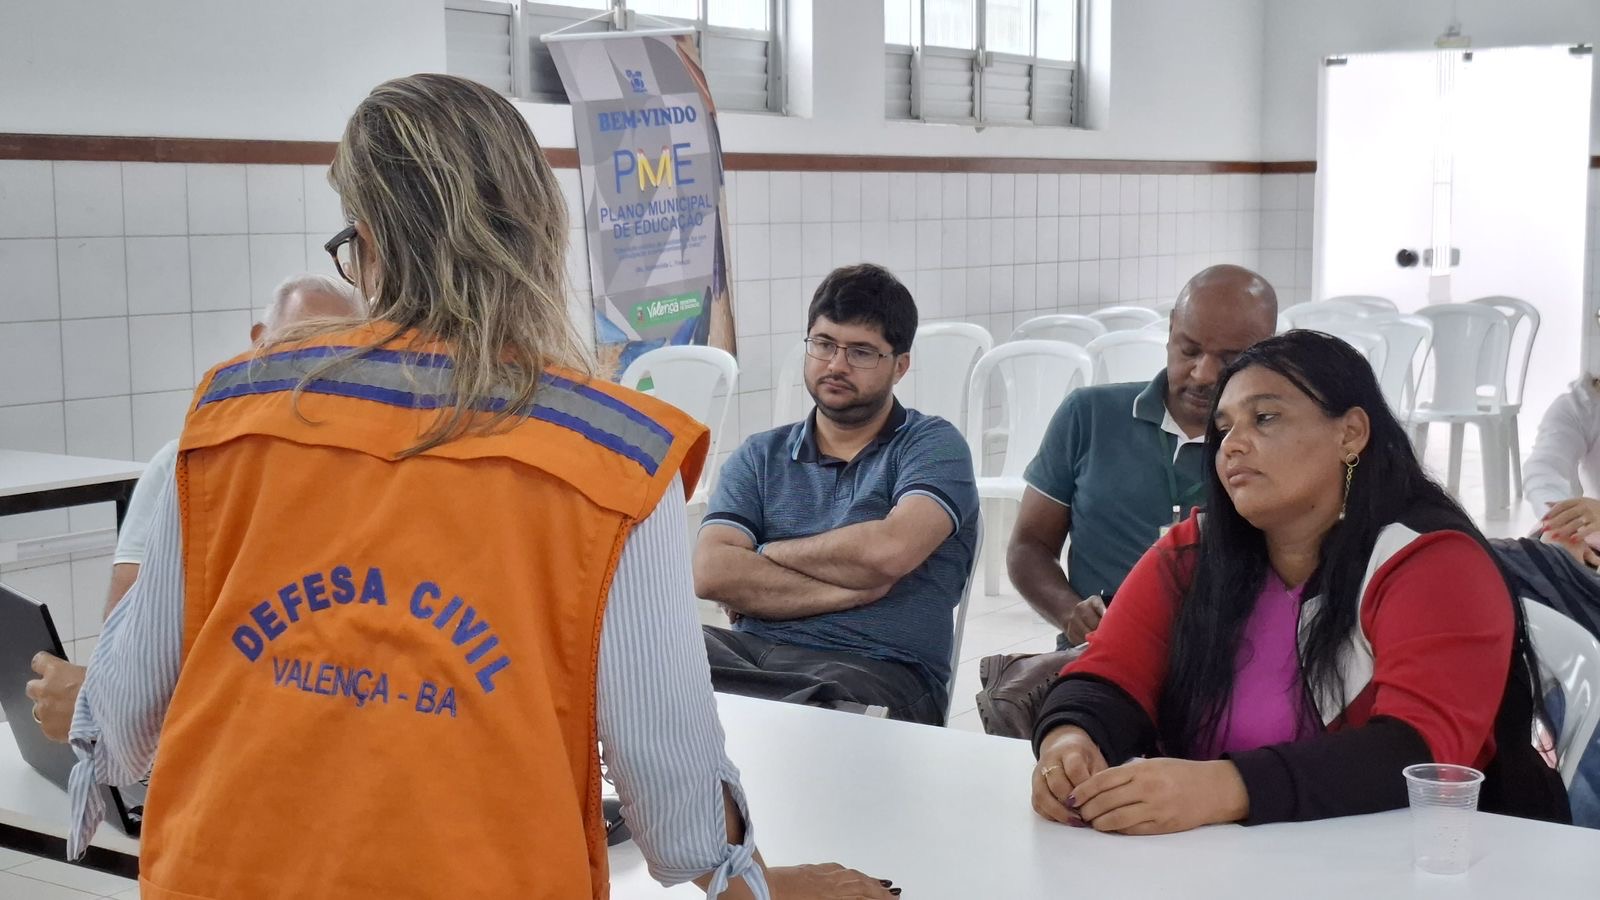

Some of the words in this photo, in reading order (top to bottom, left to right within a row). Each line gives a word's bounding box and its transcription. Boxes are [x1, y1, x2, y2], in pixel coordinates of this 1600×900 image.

[613, 142, 695, 194] PME
[600, 203, 645, 223] PLANO
[648, 194, 713, 217] MUNICIPAL
[614, 222, 630, 240] DE
[231, 565, 388, 662] DEFESA
[409, 581, 512, 694] CIVIL
[272, 656, 389, 707] VALENÇA
[415, 681, 457, 717] BA
